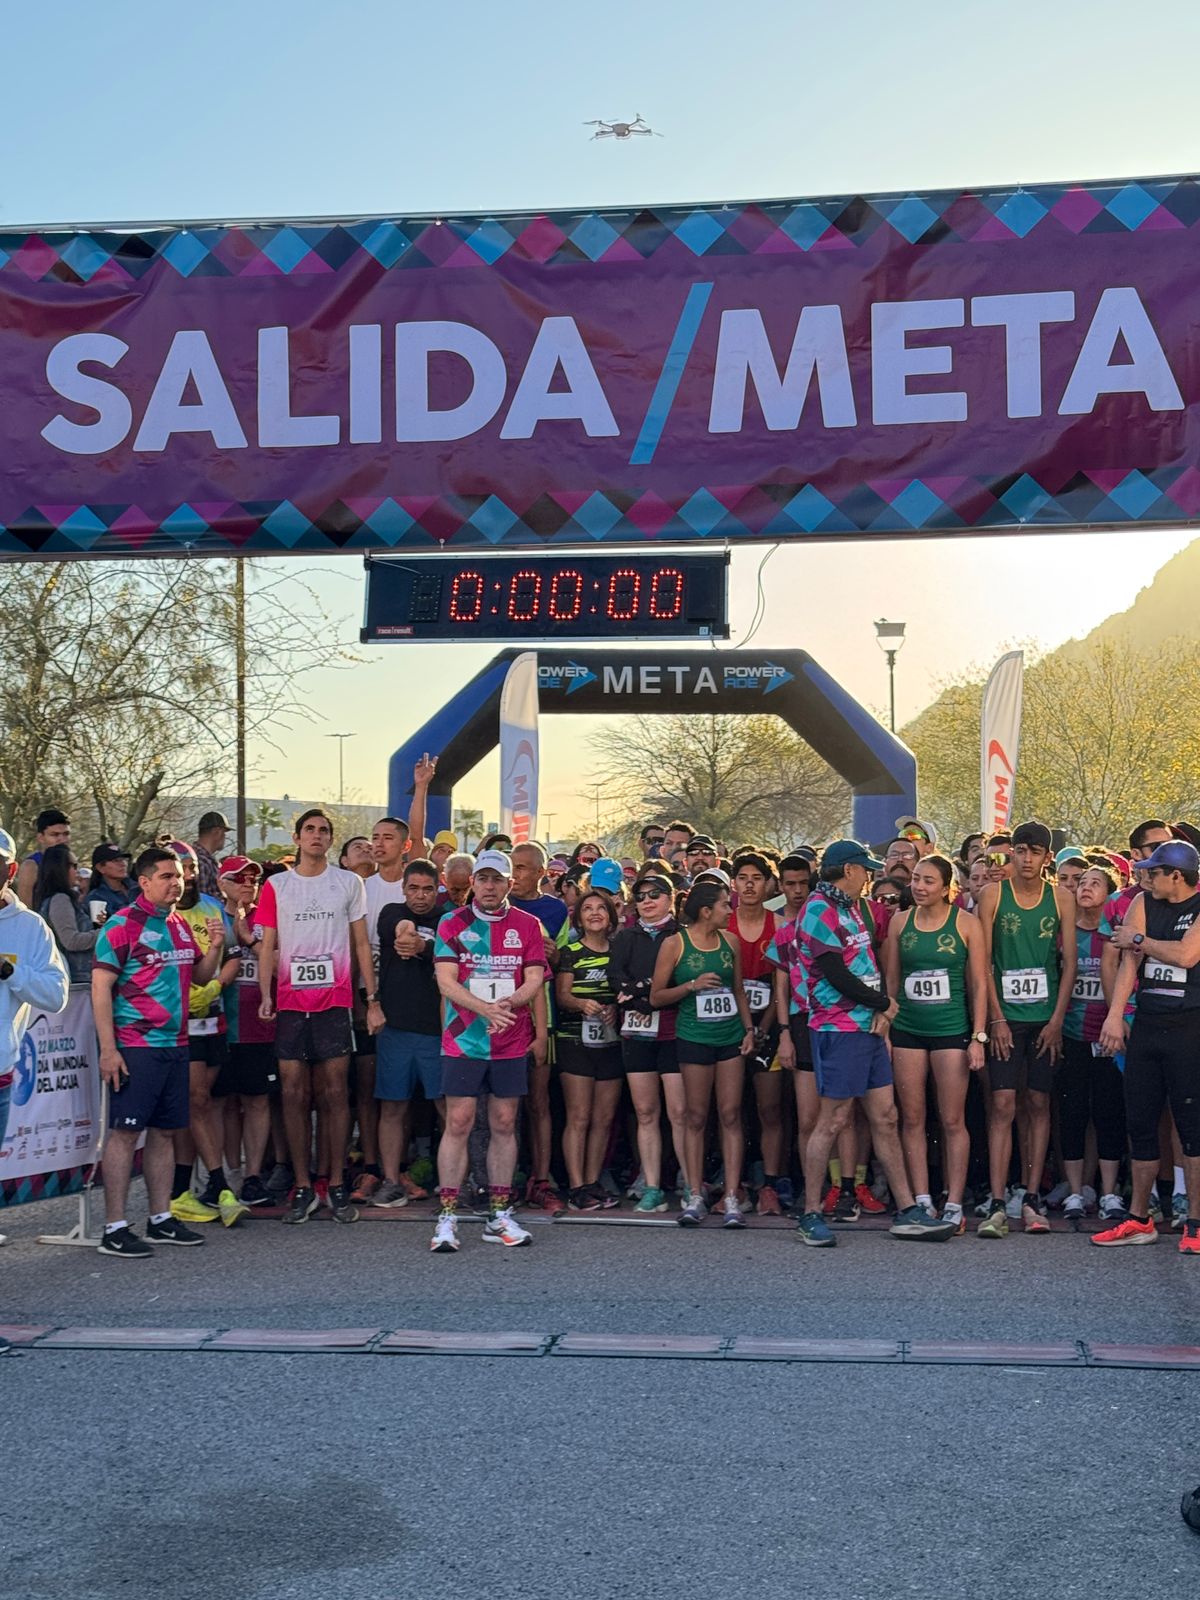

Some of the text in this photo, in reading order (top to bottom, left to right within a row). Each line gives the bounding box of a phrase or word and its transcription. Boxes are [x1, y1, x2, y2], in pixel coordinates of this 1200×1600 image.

[40, 314, 621, 455] SALIDA
[707, 286, 1186, 434] META
[449, 569, 684, 622] 0:00:00
[538, 664, 786, 694] OWER META POWER
[538, 678, 563, 689] DE
[294, 911, 334, 921] ZENITH
[161, 948, 195, 961] CARRER
[472, 953, 522, 966] CARRERA
[297, 964, 327, 982] 259
[489, 983, 496, 999] 1
[913, 980, 941, 997] 491
[1011, 979, 1039, 996] 347
[1075, 979, 1100, 996] 317
[703, 997, 732, 1014] 488
[38, 1037, 76, 1055] 22 MARZO
[52, 1055, 89, 1072] MUNDIAL
[37, 1077, 54, 1094] DEL
